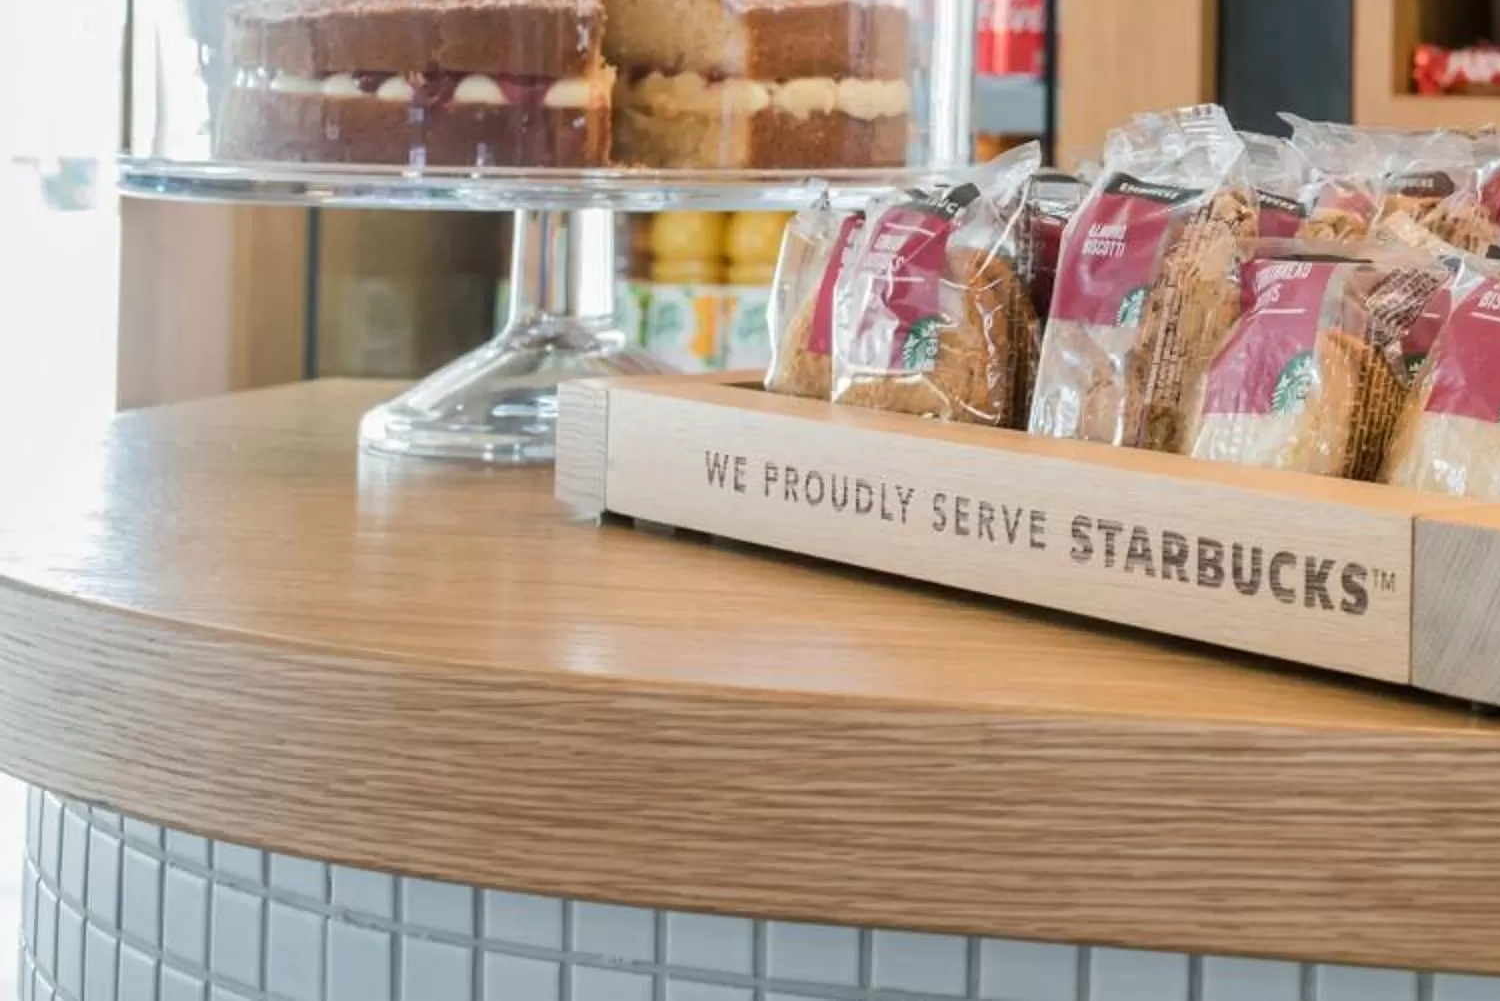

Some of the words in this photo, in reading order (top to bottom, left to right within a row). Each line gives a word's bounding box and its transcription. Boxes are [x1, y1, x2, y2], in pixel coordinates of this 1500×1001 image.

[705, 450, 748, 493] WE
[763, 461, 915, 525] PROUDLY
[931, 491, 1047, 550] SERVE
